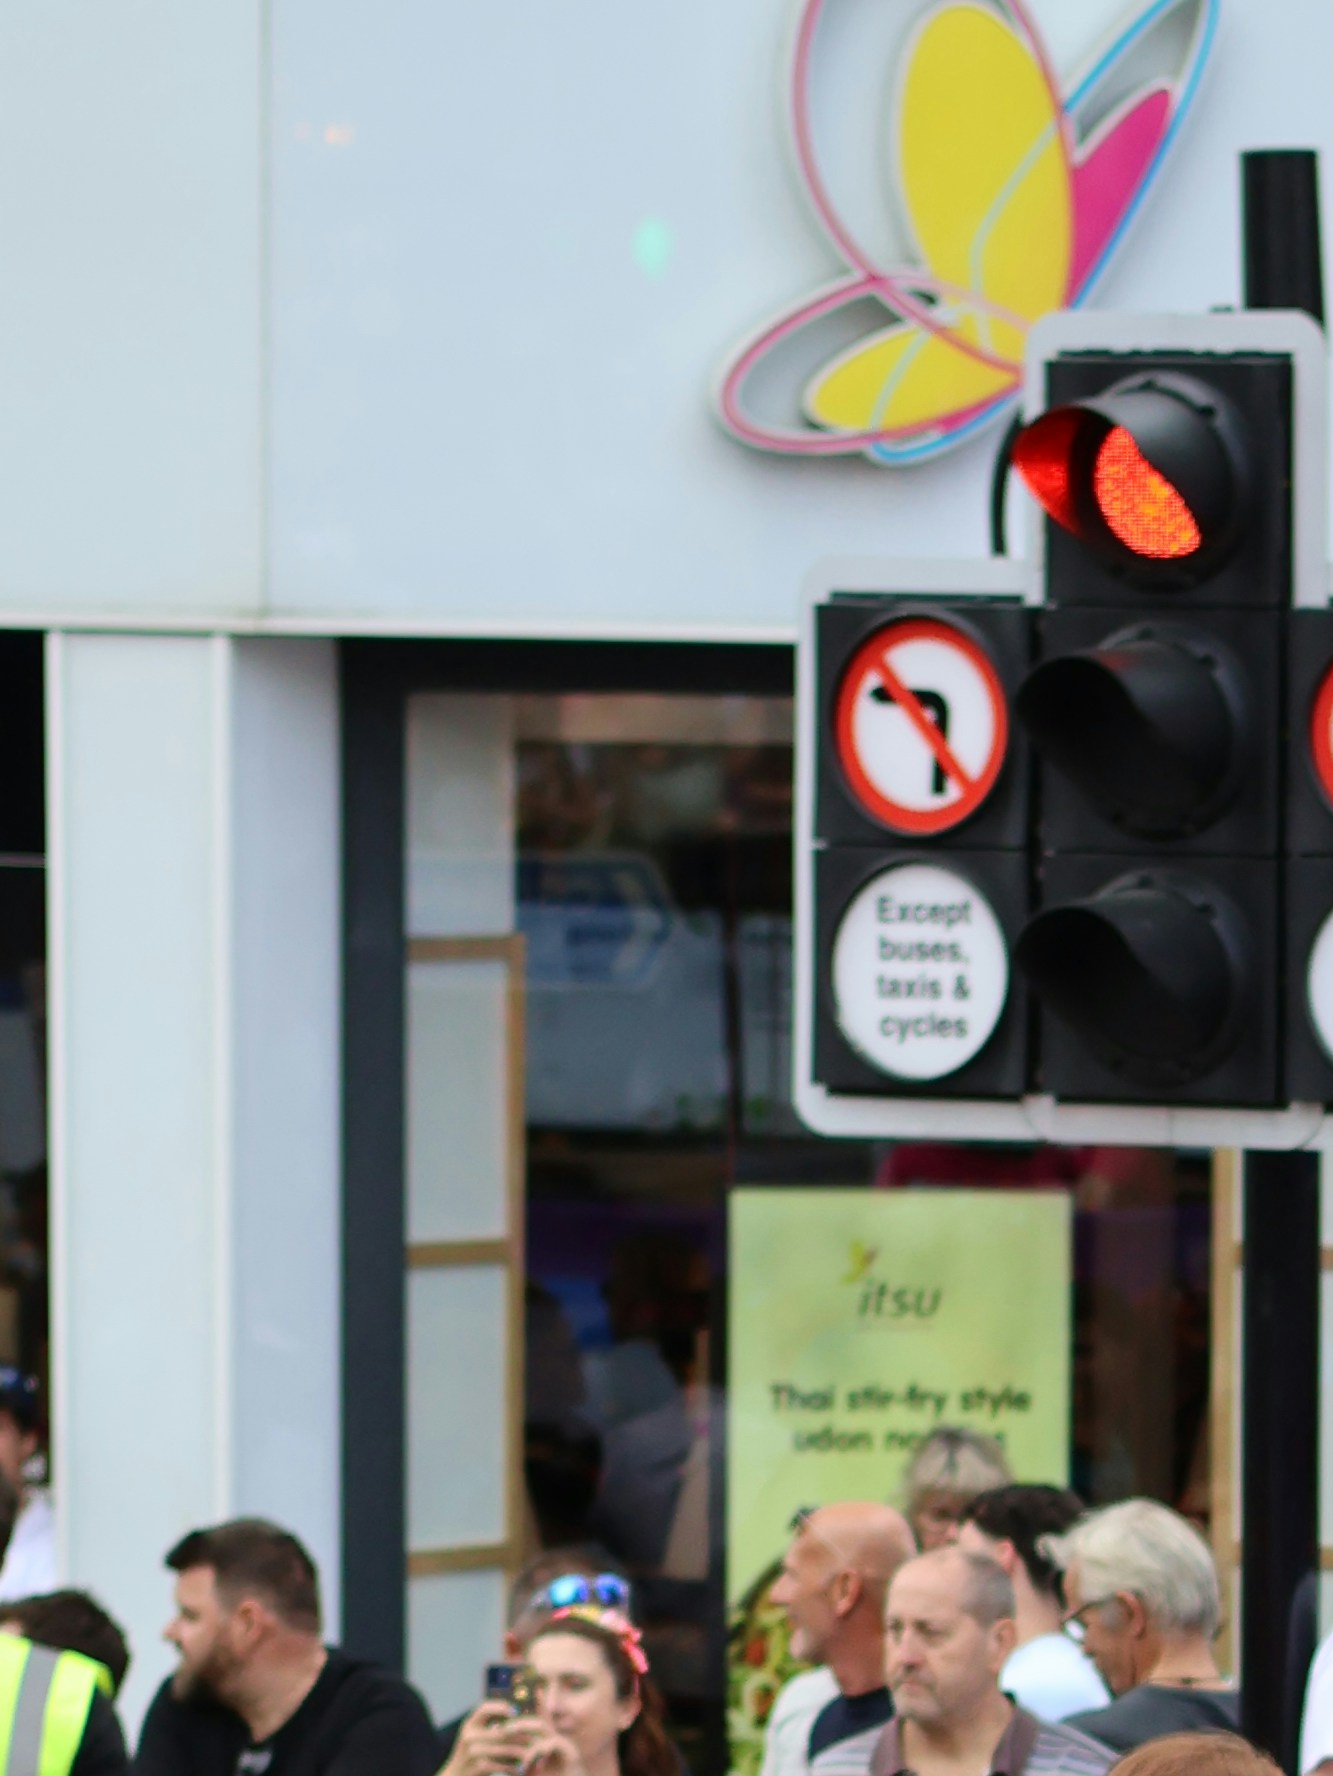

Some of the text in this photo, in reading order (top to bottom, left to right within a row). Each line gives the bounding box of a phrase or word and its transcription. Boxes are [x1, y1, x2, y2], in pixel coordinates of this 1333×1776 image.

[878, 895, 972, 930] Except
[879, 933, 970, 964] buses,
[876, 973, 971, 1000] taxis &
[880, 1012, 968, 1043] cycles
[857, 1279, 943, 1318] itsu
[771, 1383, 835, 1412] Thai
[960, 1384, 1032, 1418] style
